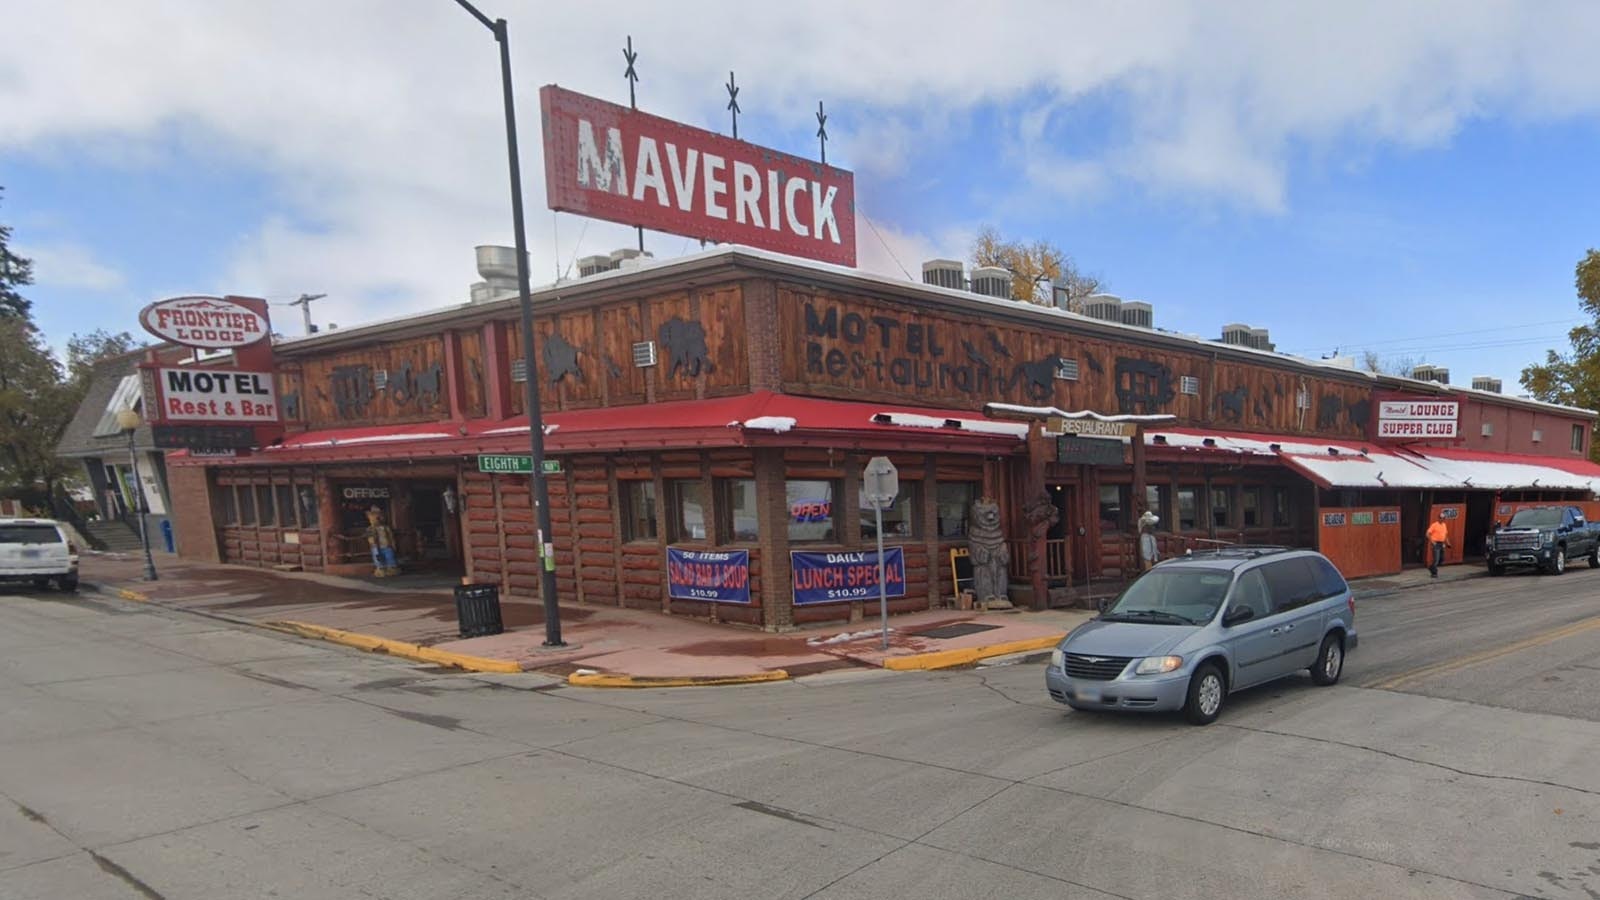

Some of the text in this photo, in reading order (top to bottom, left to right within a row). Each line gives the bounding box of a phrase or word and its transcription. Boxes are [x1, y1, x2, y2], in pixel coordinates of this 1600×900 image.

[577, 119, 841, 244] MAVERICK
[156, 308, 260, 333] FRONTIER
[176, 328, 245, 342] LODGE
[805, 303, 944, 357] MOTEL
[167, 371, 269, 394] MOTEL
[168, 397, 274, 417] Rest & Bar
[1410, 404, 1455, 417] LOUNGE
[1062, 420, 1124, 435] RESTAURANT
[1383, 423, 1453, 434] SUPPER CLUB
[484, 457, 519, 470] EIGHTH
[343, 487, 390, 499] OFFICE
[791, 502, 830, 517] OPEN
[826, 552, 865, 563] DAILY
[669, 561, 695, 586] SALAD
[696, 563, 712, 587] BAR
[723, 564, 748, 589] SOUP
[794, 562, 902, 589] LUNCH SPECAL
[690, 588, 718, 598] $10.99
[828, 588, 867, 598] $10.99
